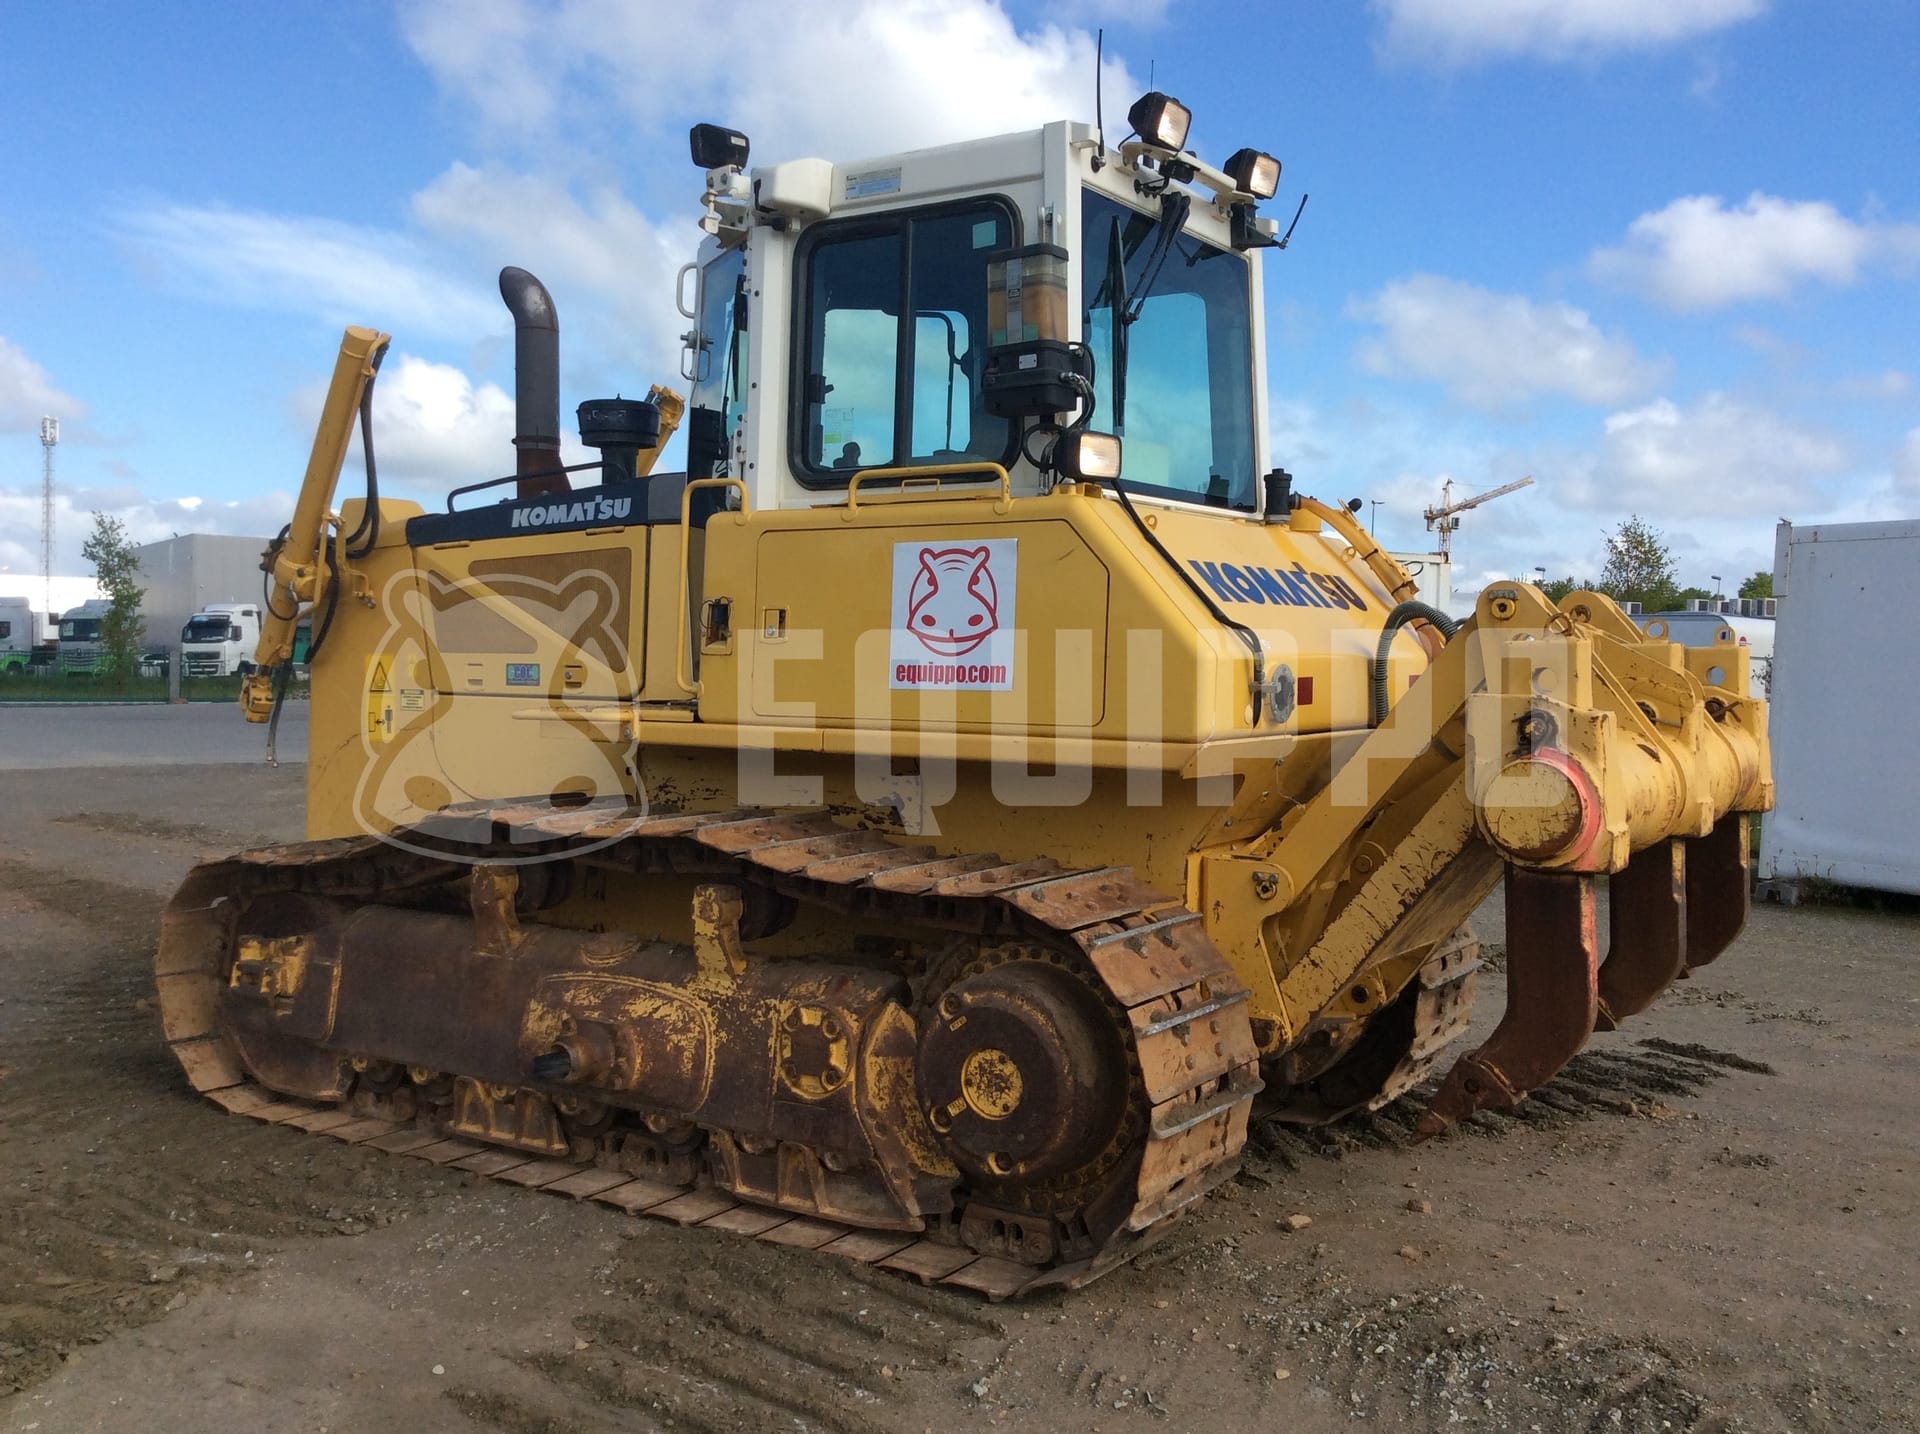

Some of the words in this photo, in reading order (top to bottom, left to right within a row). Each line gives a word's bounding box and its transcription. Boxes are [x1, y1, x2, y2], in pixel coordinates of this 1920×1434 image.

[511, 495, 632, 528] KOMATSU
[1187, 560, 1368, 612] KOMATSU
[896, 661, 1006, 684] equippo.com
